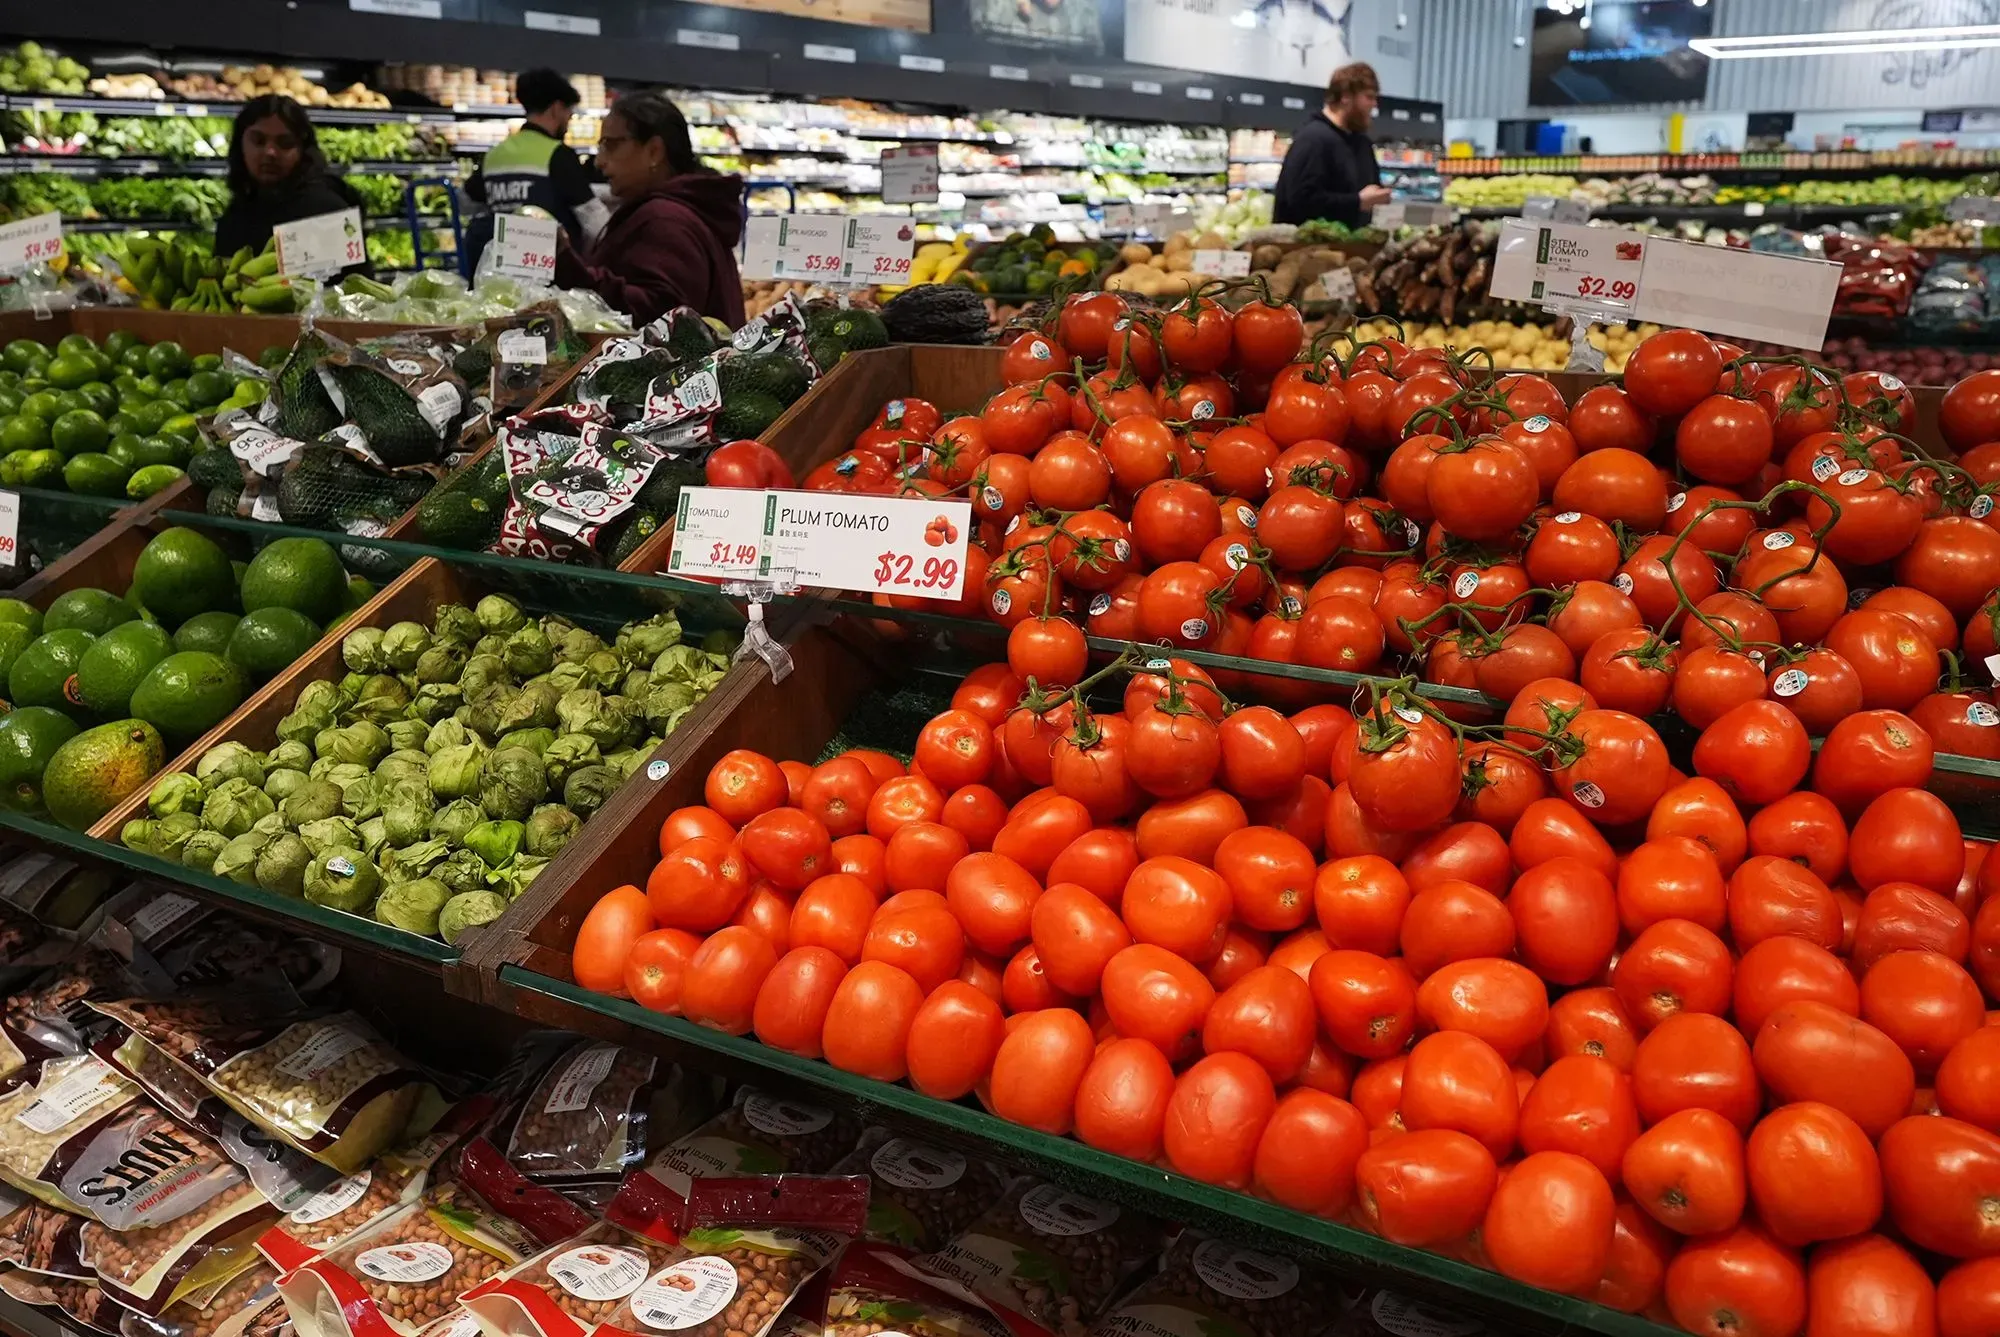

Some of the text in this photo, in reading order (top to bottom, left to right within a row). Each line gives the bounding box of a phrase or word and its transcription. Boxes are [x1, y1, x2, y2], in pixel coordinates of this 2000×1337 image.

[25, 238, 60, 260] $4.49
[1551, 239, 1578, 249] STEM
[1551, 247, 1589, 258] TOMATO
[522, 252, 556, 269] $4.99
[805, 255, 840, 271] $5.99
[874, 256, 910, 273] $2.99
[1578, 276, 1636, 300] $2.99
[689, 507, 730, 519] TOMATILLO
[781, 508, 890, 532] PLUM TOMATO
[710, 542, 757, 565] $1.49
[874, 551, 958, 590] $2.99
[79, 1131, 197, 1206] NUTS
[688, 1149, 728, 1172] Natural
[117, 1156, 202, 1213] PREMIUM QUALITY
[132, 1169, 202, 1214] 100% NATURAL
[702, 1260, 732, 1273] Redskin
[962, 1250, 1003, 1278] Natural
